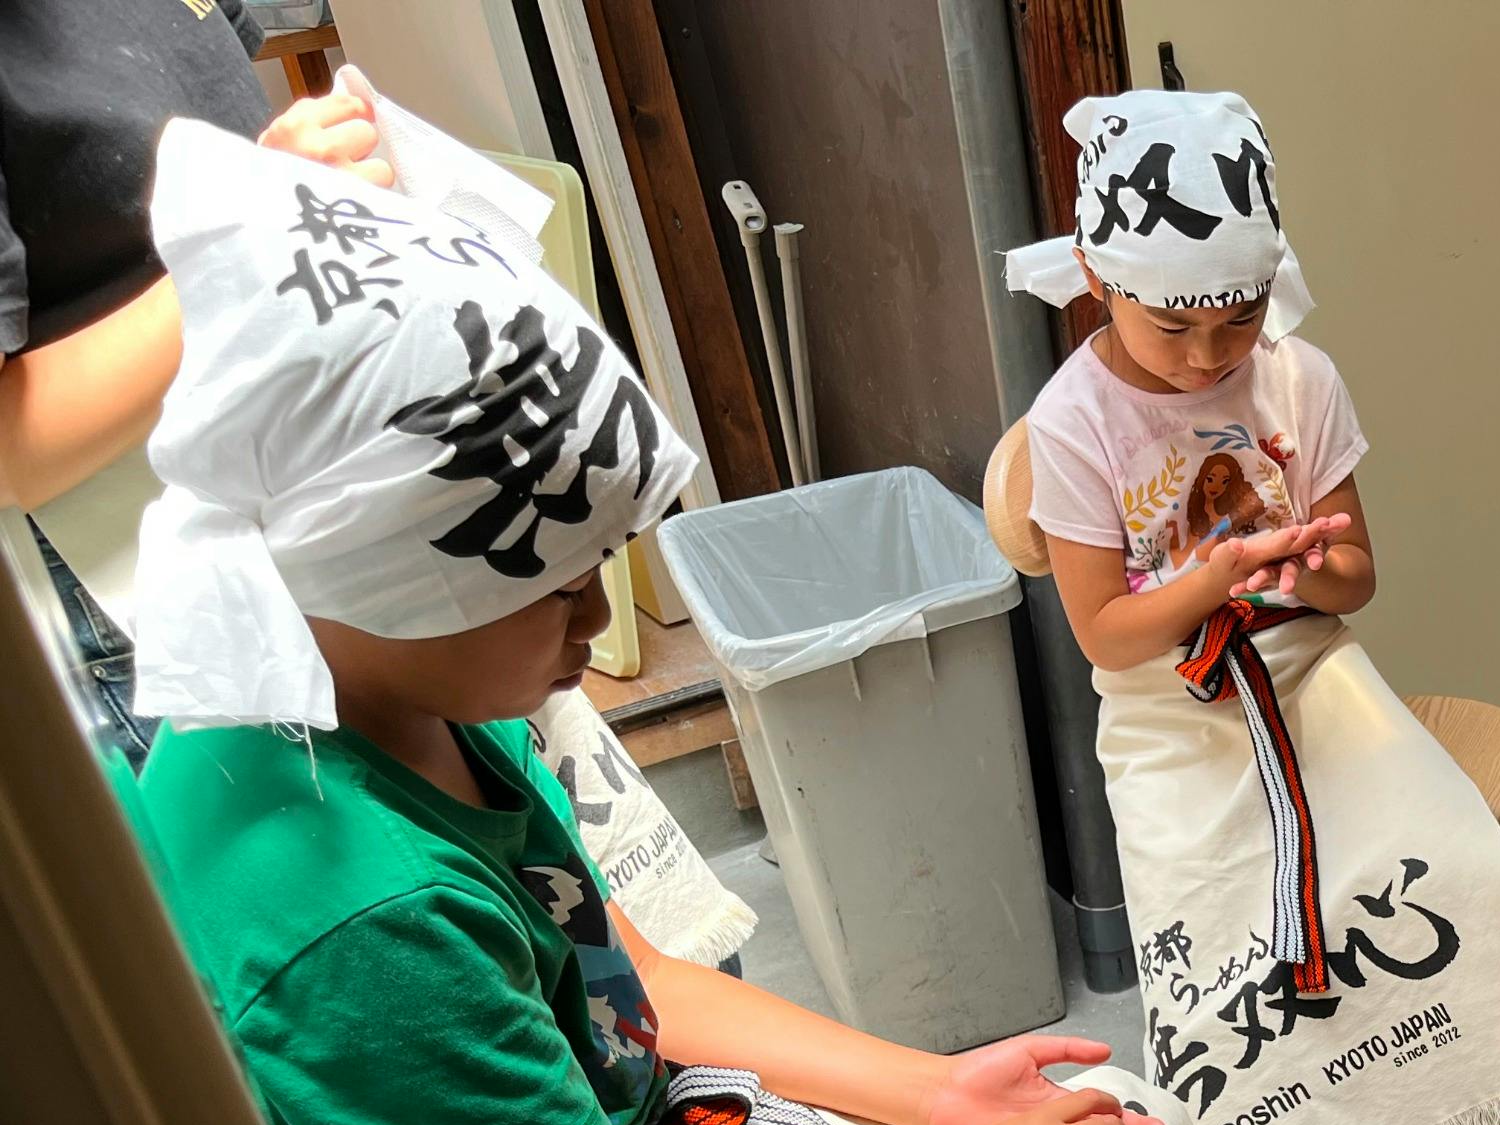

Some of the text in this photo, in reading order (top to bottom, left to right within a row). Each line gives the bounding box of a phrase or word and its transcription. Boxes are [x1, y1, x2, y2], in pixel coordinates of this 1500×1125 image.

[1321, 1035, 1388, 1086] KYOTO
[1390, 1002, 1452, 1048] JAPAN
[1393, 1026, 1462, 1068] since 2012
